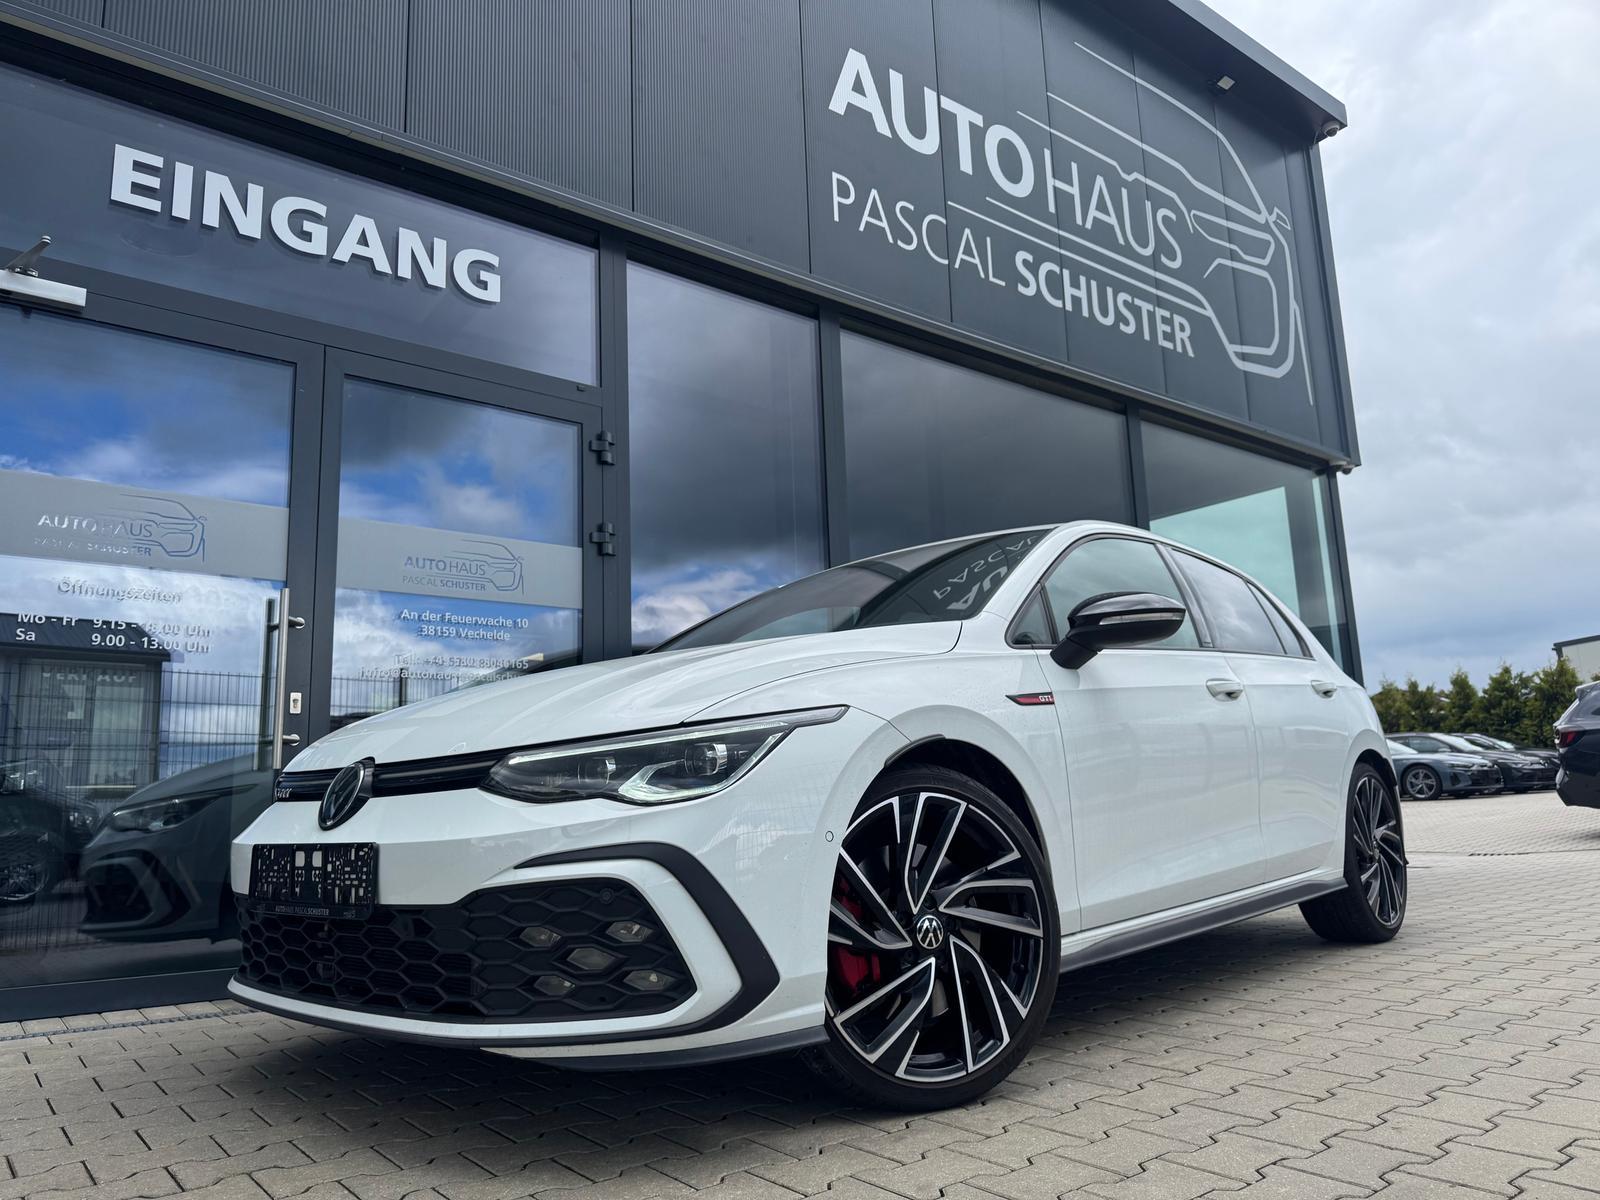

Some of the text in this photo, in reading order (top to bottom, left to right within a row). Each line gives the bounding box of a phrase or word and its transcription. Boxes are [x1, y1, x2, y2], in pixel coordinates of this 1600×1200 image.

[828, 48, 1182, 269] AUTOHAUS
[110, 143, 501, 303] EINGANG
[831, 171, 1195, 358] PASCAL SCHUSTER
[404, 556, 486, 576] AUTOHAUS
[402, 575, 486, 592] PASCAL SCHUSTER
[18, 613, 46, 624] Mo
[62, 615, 79, 626] Fr
[93, 618, 126, 630] 9.15
[401, 609, 529, 629] An der Feuerwache 10
[16, 627, 36, 641] Sa
[91, 633, 126, 647] 9.00
[141, 637, 181, 650] 13.00
[420, 625, 511, 641] 38159 Vechelde
